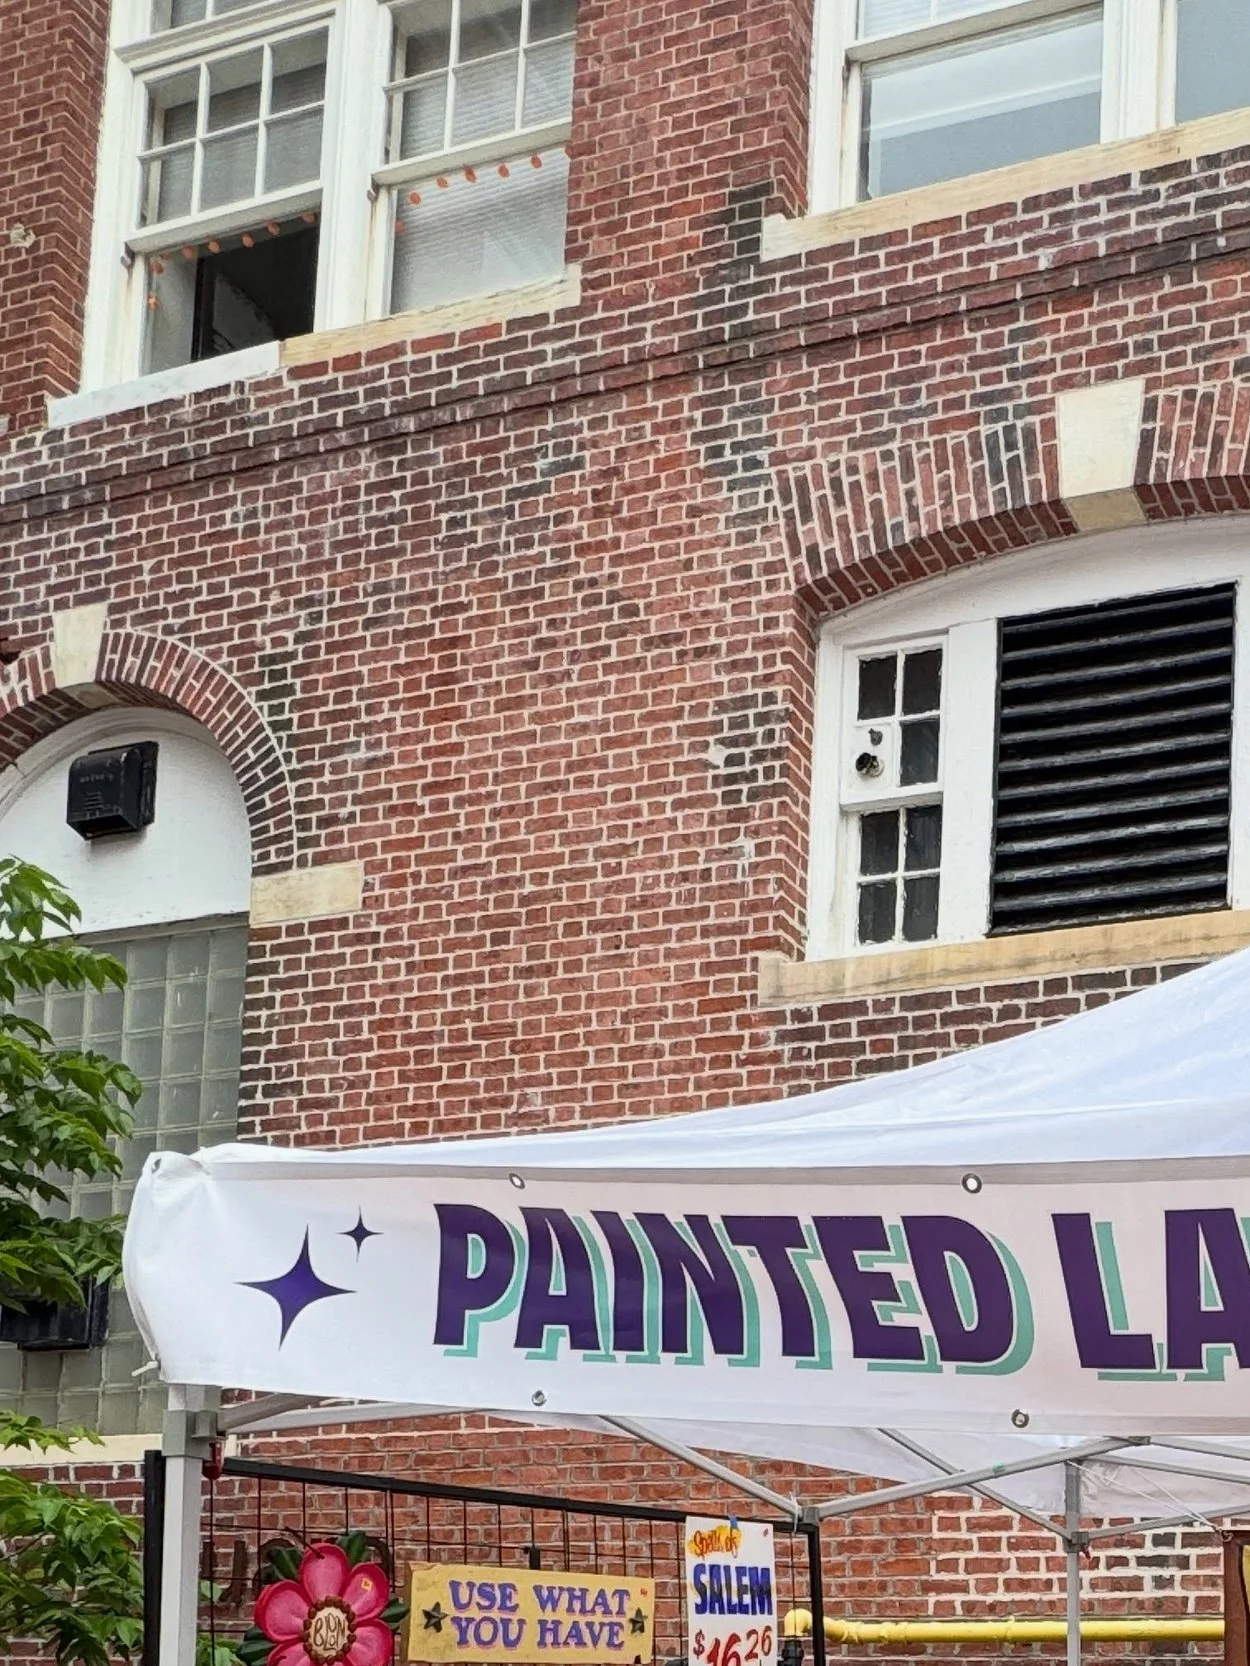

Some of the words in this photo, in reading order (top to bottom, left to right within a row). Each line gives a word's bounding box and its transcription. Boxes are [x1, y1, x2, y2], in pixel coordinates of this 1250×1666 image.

[433, 1203, 1034, 1374] PAINTED
[449, 1580, 520, 1613] USE
[533, 1584, 630, 1617] WHAT
[693, 1563, 773, 1615] SALEM
[451, 1616, 527, 1649] YOU
[537, 1619, 625, 1649] HAVE
